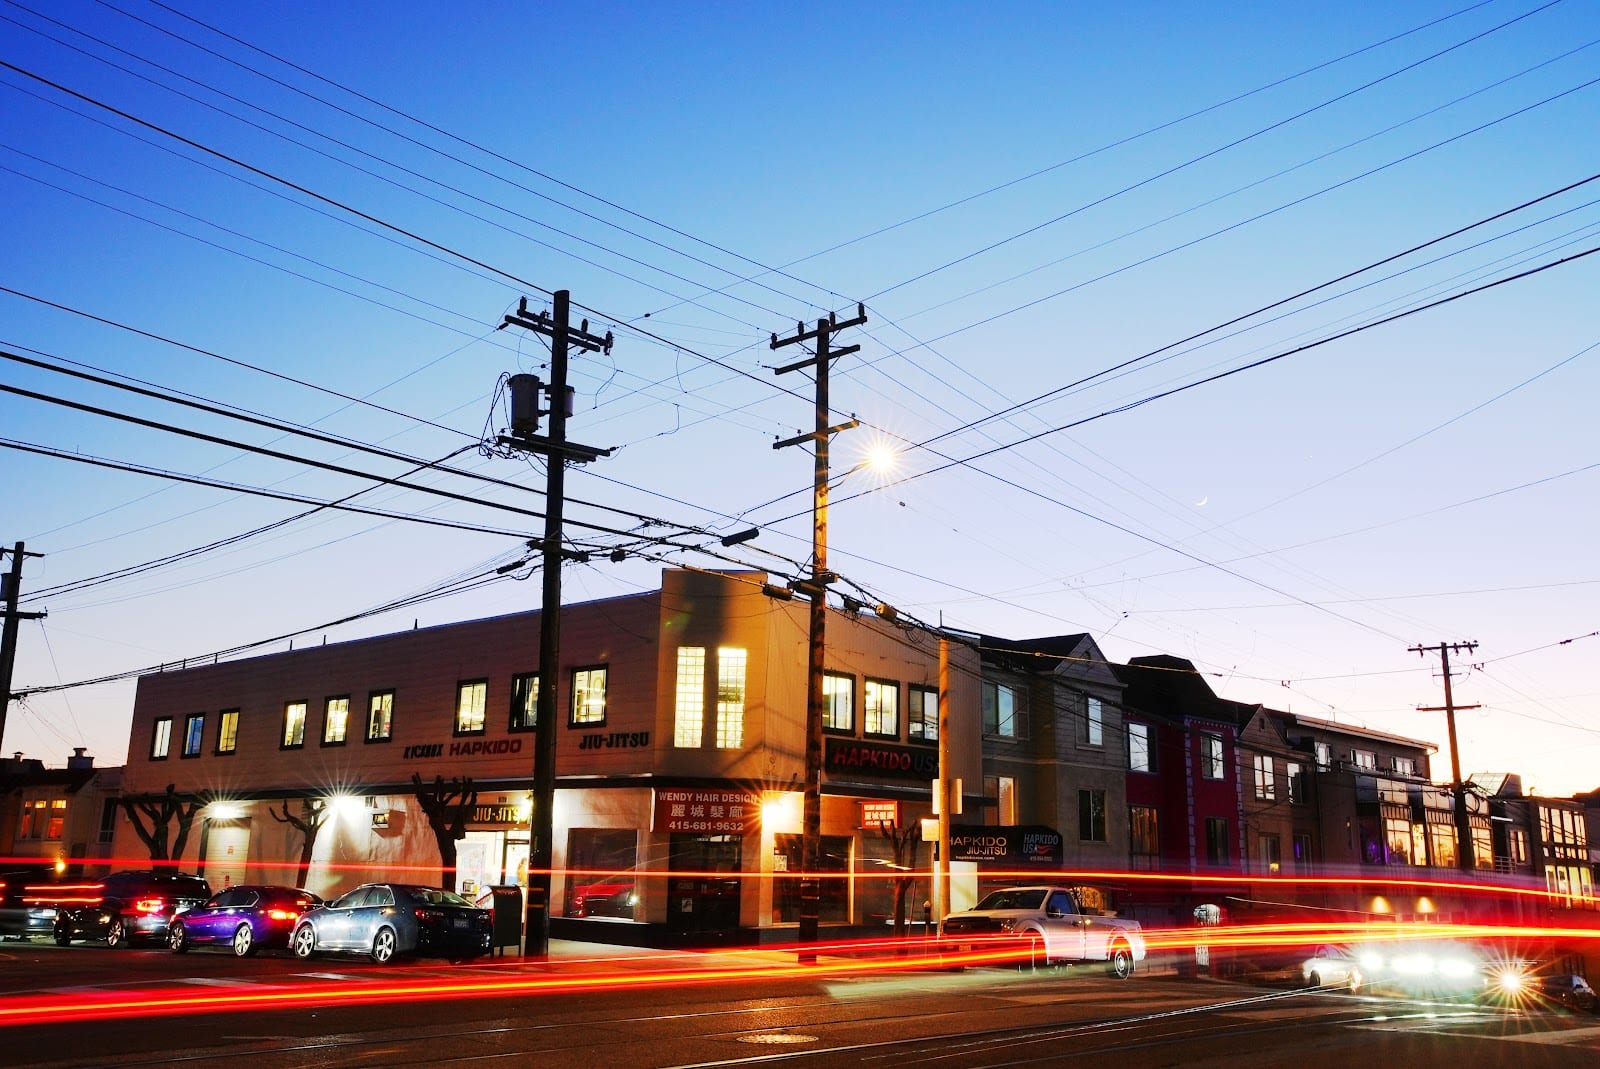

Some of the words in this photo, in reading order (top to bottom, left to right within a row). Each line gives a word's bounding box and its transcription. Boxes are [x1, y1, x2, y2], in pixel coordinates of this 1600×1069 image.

[579, 732, 649, 749] JIU-JITSU
[449, 739, 522, 756] HAPKIDO
[833, 747, 911, 770] HAPKIDO
[659, 791, 693, 801] WENDY
[696, 793, 719, 802] HAIR
[721, 794, 758, 803] DESIGN
[670, 803, 743, 818] 麗城髮廊
[669, 820, 744, 831] 415-681-9632
[1023, 833, 1059, 845] HAPKIDO
[966, 846, 1007, 856] JIU-JITSU
